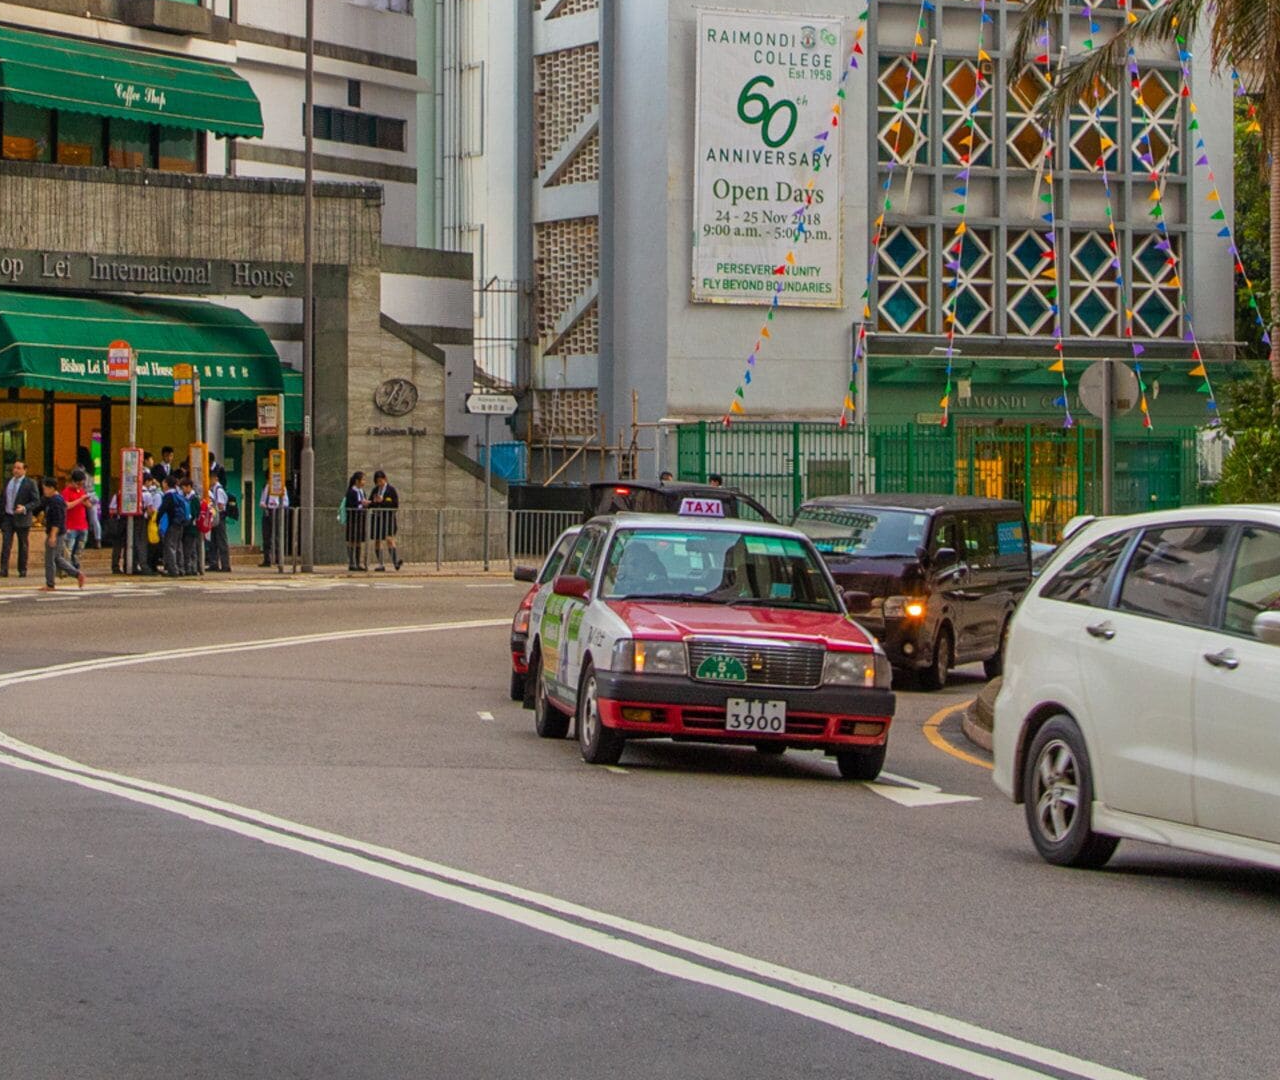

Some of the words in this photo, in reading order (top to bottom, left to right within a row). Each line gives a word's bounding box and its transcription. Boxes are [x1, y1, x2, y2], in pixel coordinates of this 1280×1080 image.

[707, 28, 796, 48] RAIMONDI
[754, 49, 833, 69] COLLEGE
[810, 69, 833, 81] 1958
[114, 82, 141, 107] Coffee
[144, 86, 167, 111] Shop
[706, 147, 833, 168] ANNIVERSARY
[713, 178, 769, 206] Open
[776, 182, 824, 205] Days
[716, 210, 731, 223] 24
[744, 211, 759, 225] 25
[762, 210, 789, 225] Nov
[792, 213, 822, 226] 2018
[703, 224, 731, 237] 9:00
[734, 226, 762, 238] a.m.
[803, 229, 832, 243] p.m.
[41, 253, 71, 280] Lei
[90, 255, 212, 286] International
[232, 262, 295, 288] House
[792, 266, 822, 277] UNITY
[702, 278, 721, 290] FLY
[722, 279, 764, 291] BEYOND
[766, 280, 833, 293] BOUNDARIES
[60, 357, 86, 376] Bishop
[87, 359, 100, 375] Lei
[952, 394, 1028, 409] AIMONDI
[684, 500, 721, 515] TAXI
[718, 662, 727, 673] 5
[745, 701, 769, 715] TT
[729, 713, 782, 732] 3900
